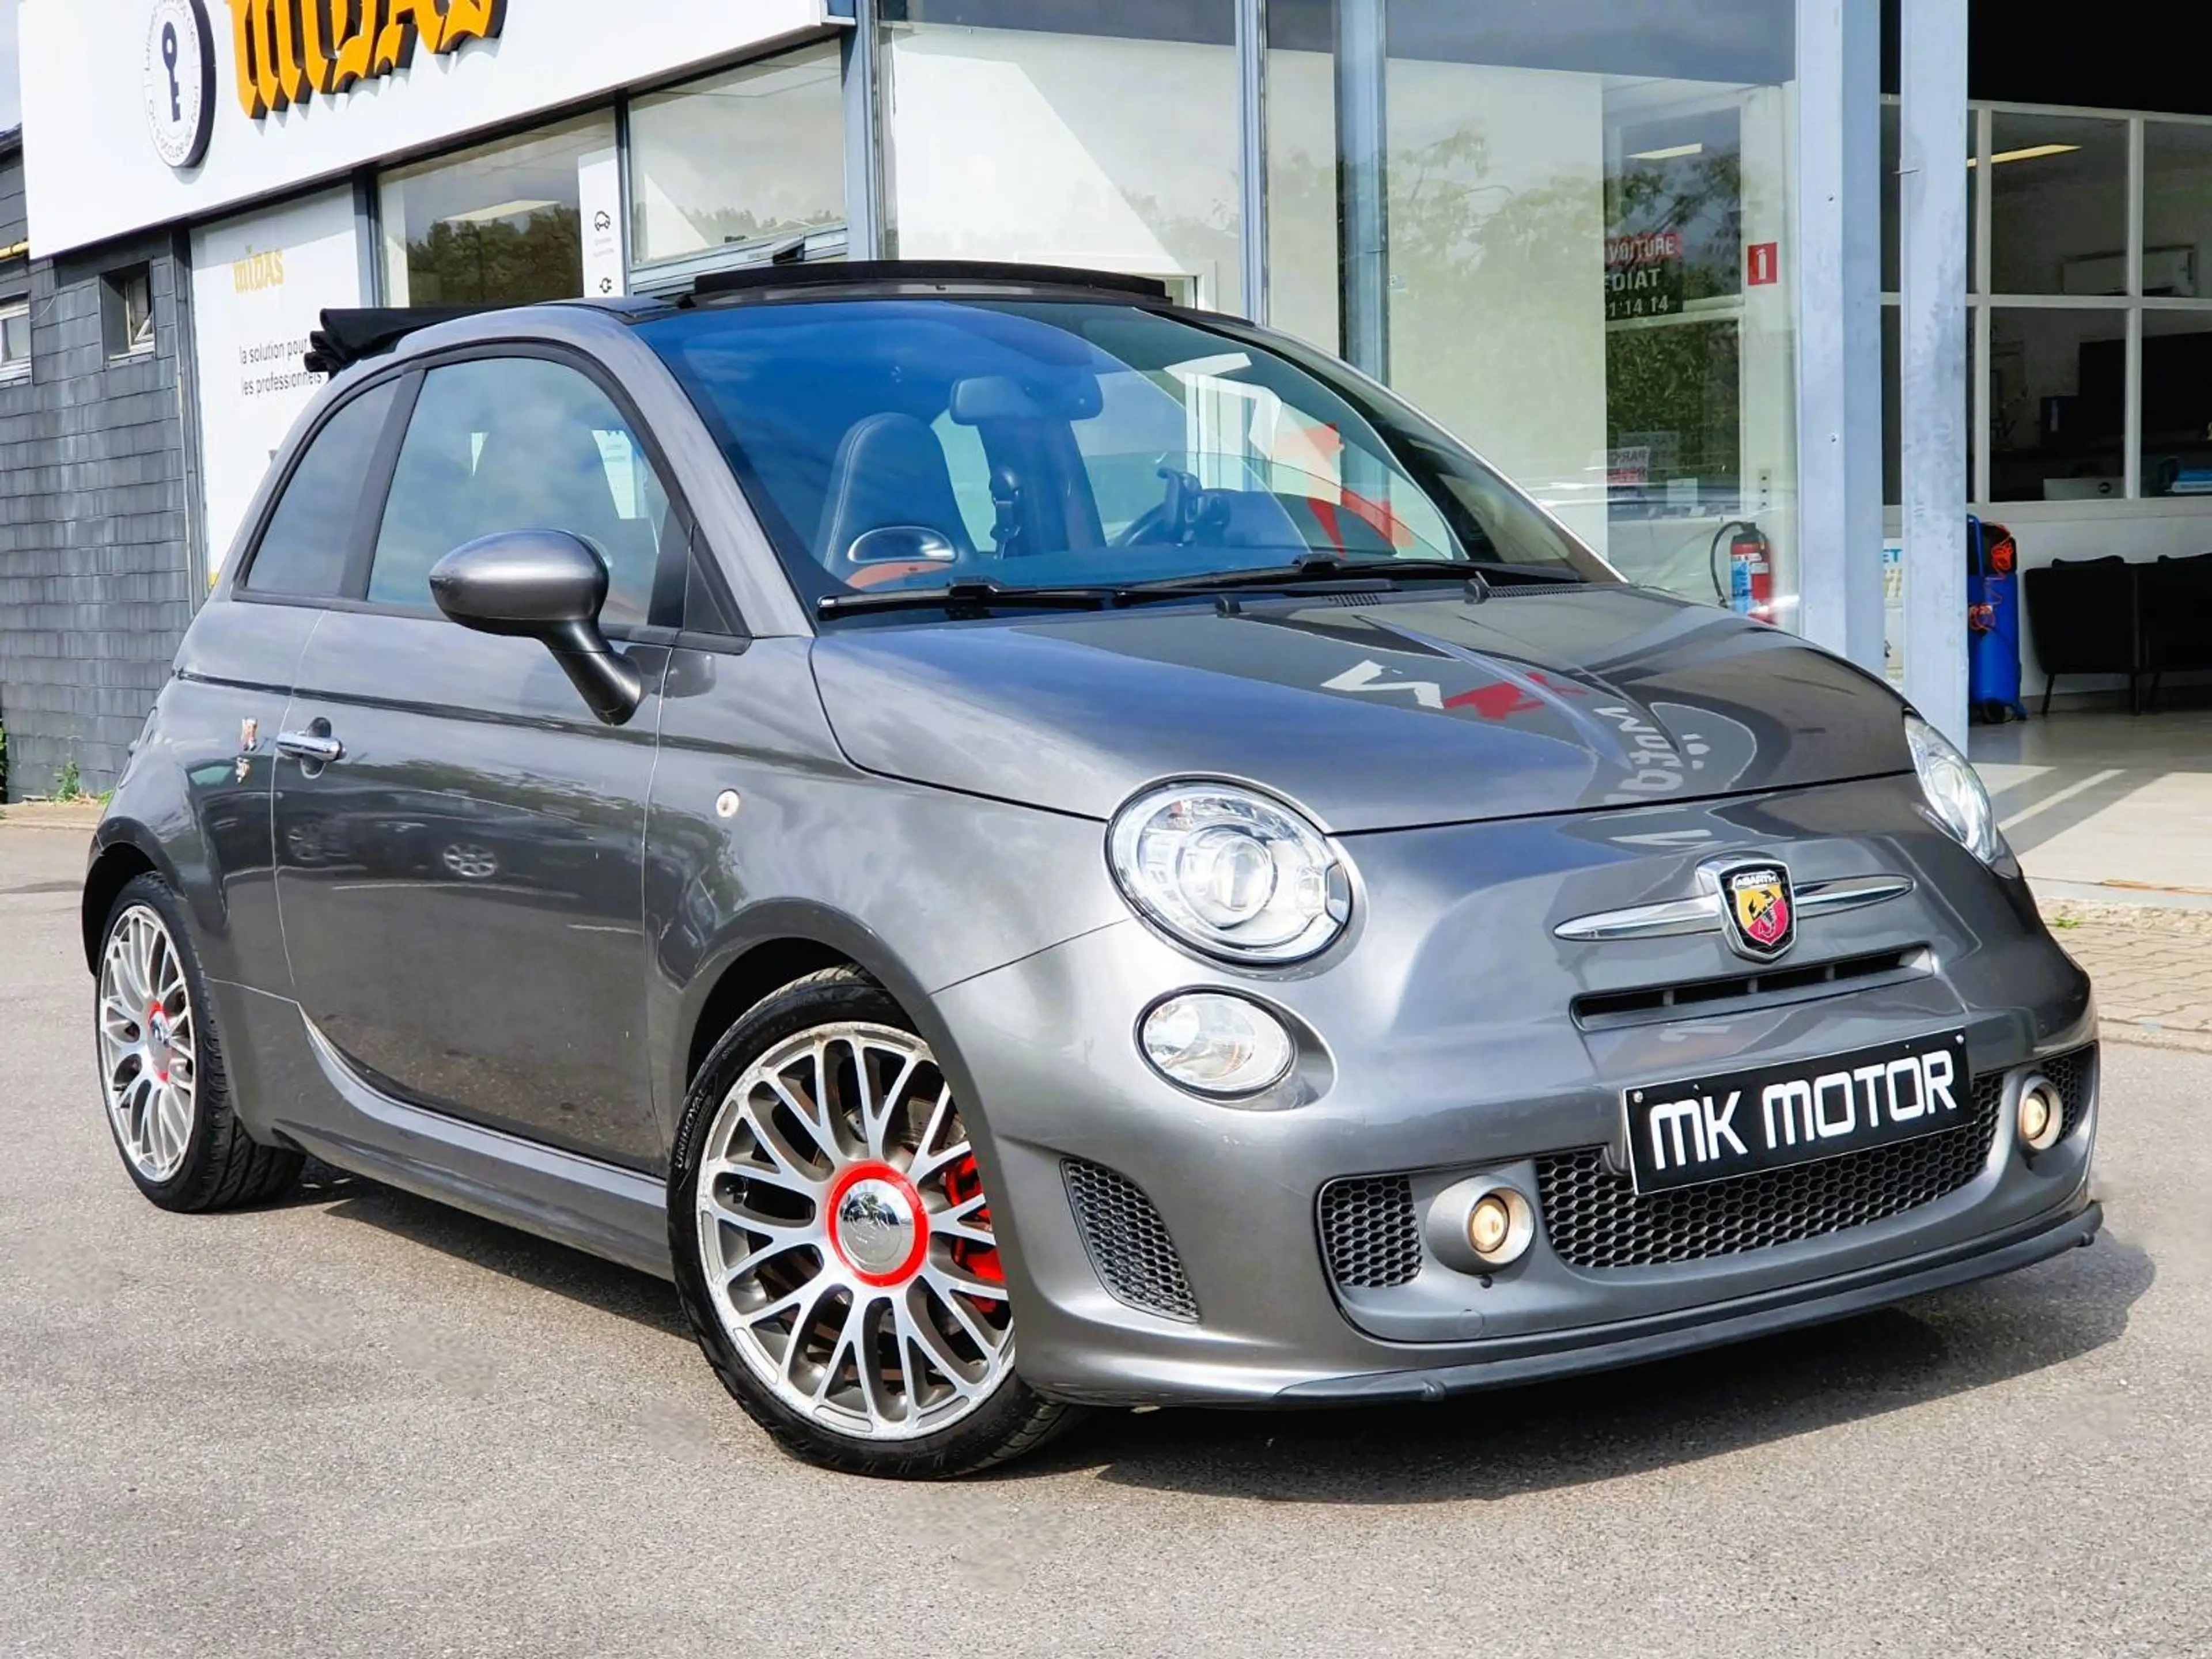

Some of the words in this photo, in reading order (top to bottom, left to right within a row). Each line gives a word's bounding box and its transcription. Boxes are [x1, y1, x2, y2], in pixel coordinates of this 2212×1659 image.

[239, 345, 248, 364] la
[249, 340, 284, 363] solution
[287, 339, 308, 361] pour
[242, 376, 253, 395] les
[256, 372, 322, 397] professionnels
[1736, 874, 1777, 886] ABARTH
[1650, 1090, 1748, 1170] MK
[1762, 1050, 1957, 1151] MOTOR
[675, 1088, 708, 1168] UNIROYAL
